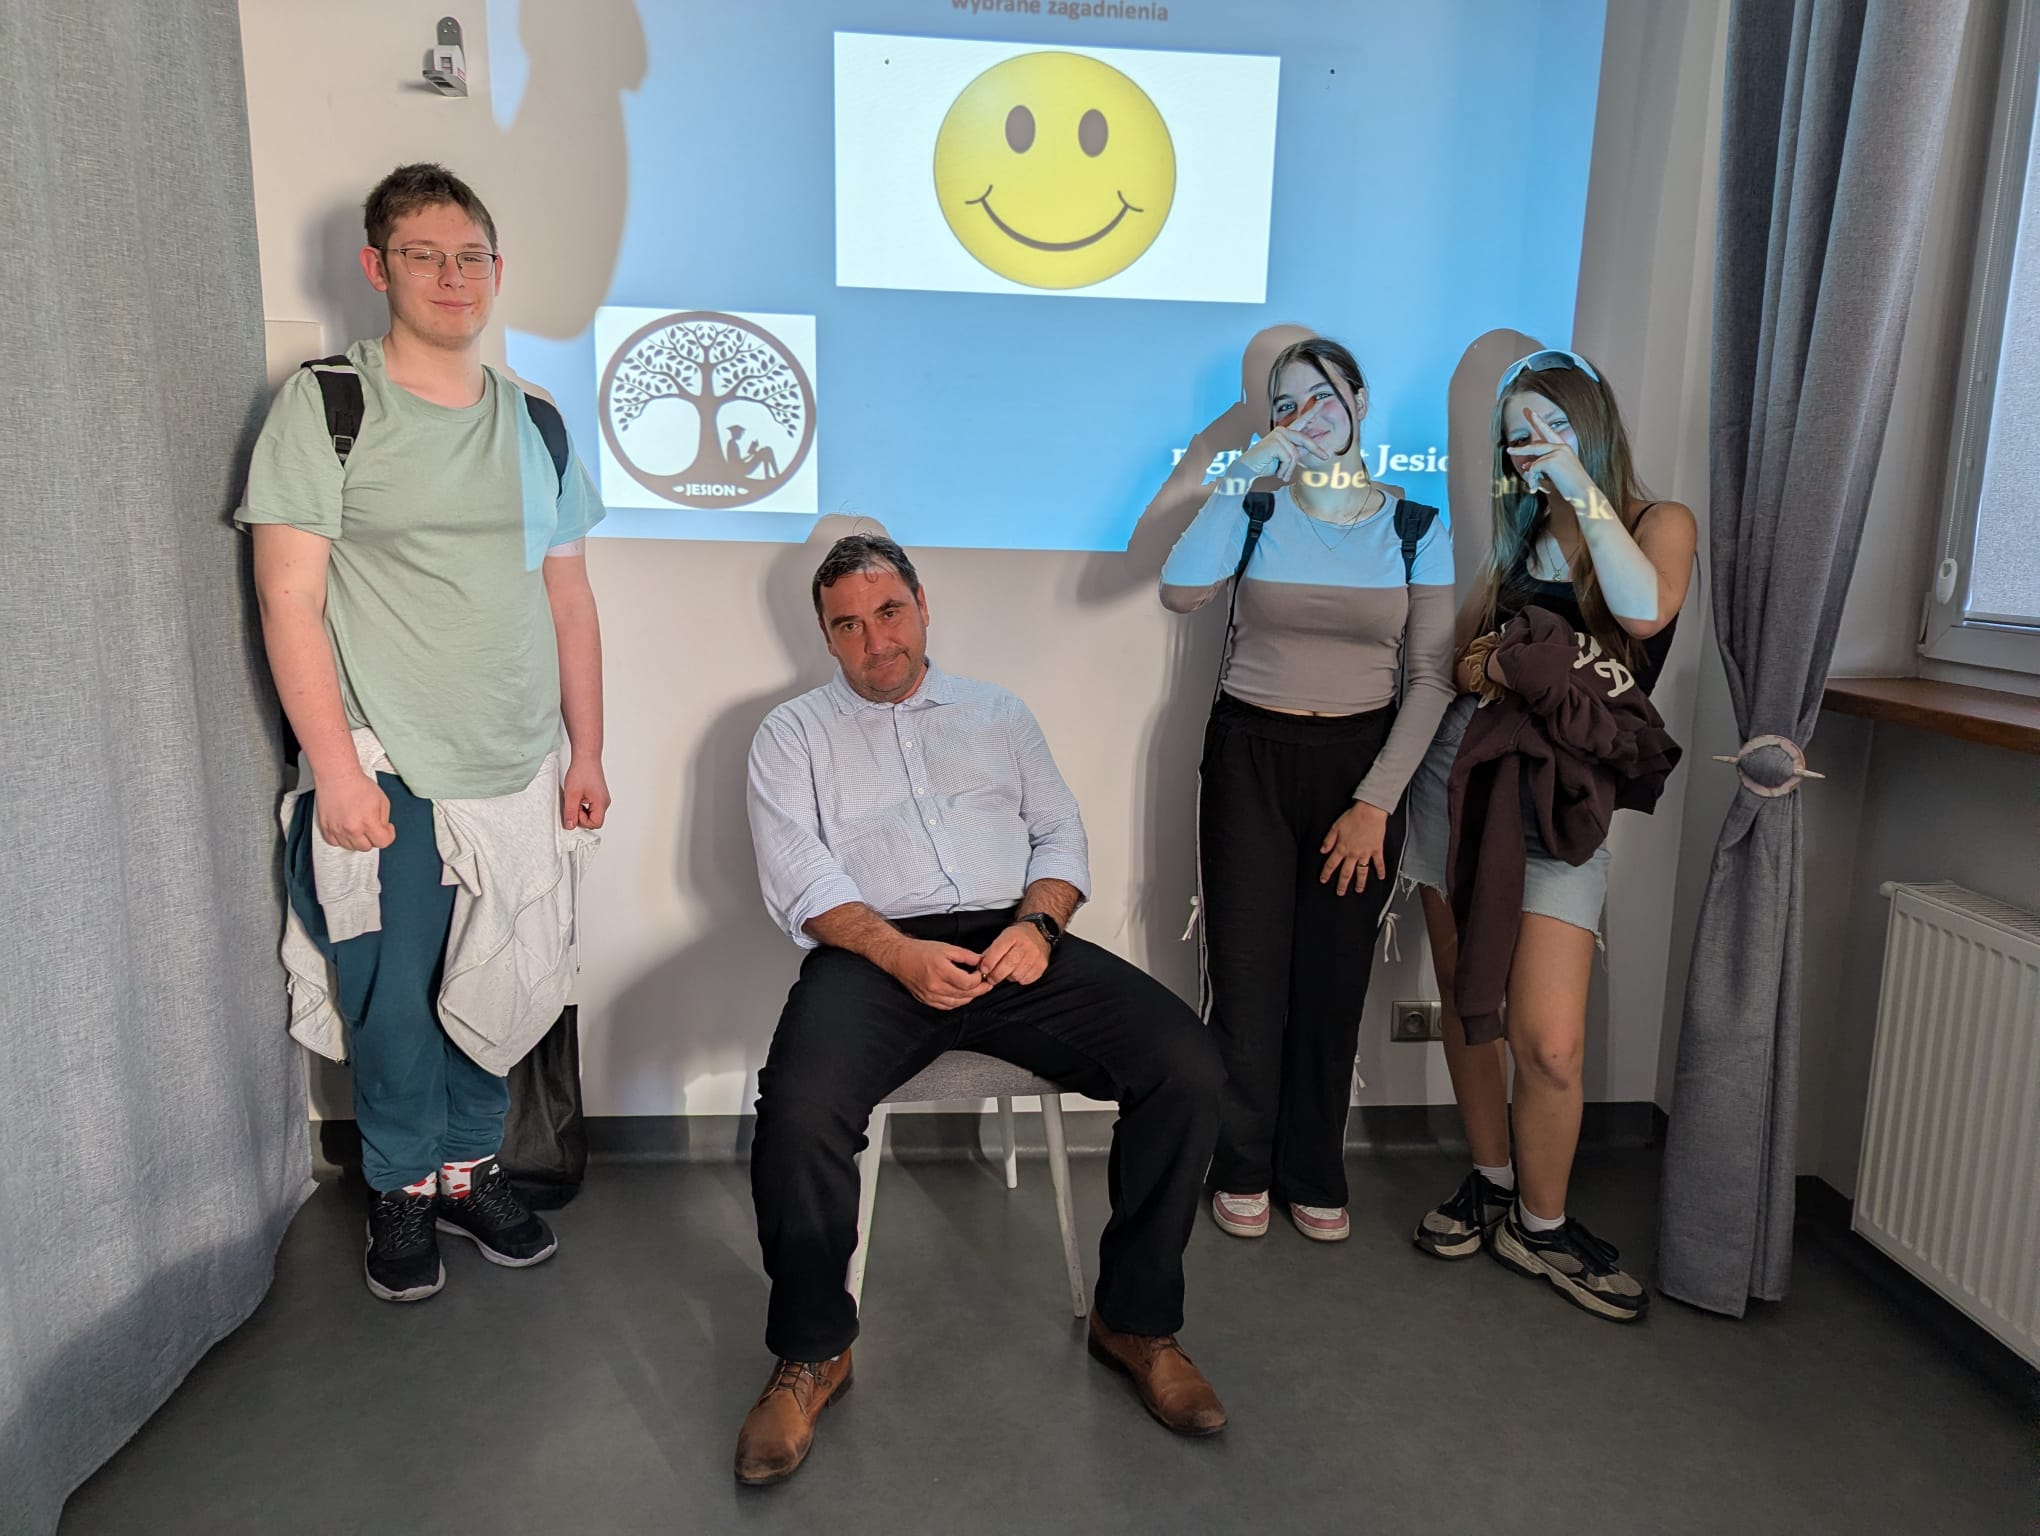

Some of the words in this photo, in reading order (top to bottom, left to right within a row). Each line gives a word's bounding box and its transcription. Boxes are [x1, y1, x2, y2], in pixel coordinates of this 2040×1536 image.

[951, 0, 1040, 15] wybrane
[1047, 0, 1168, 21] zagadnienia
[685, 483, 736, 497] JESION
